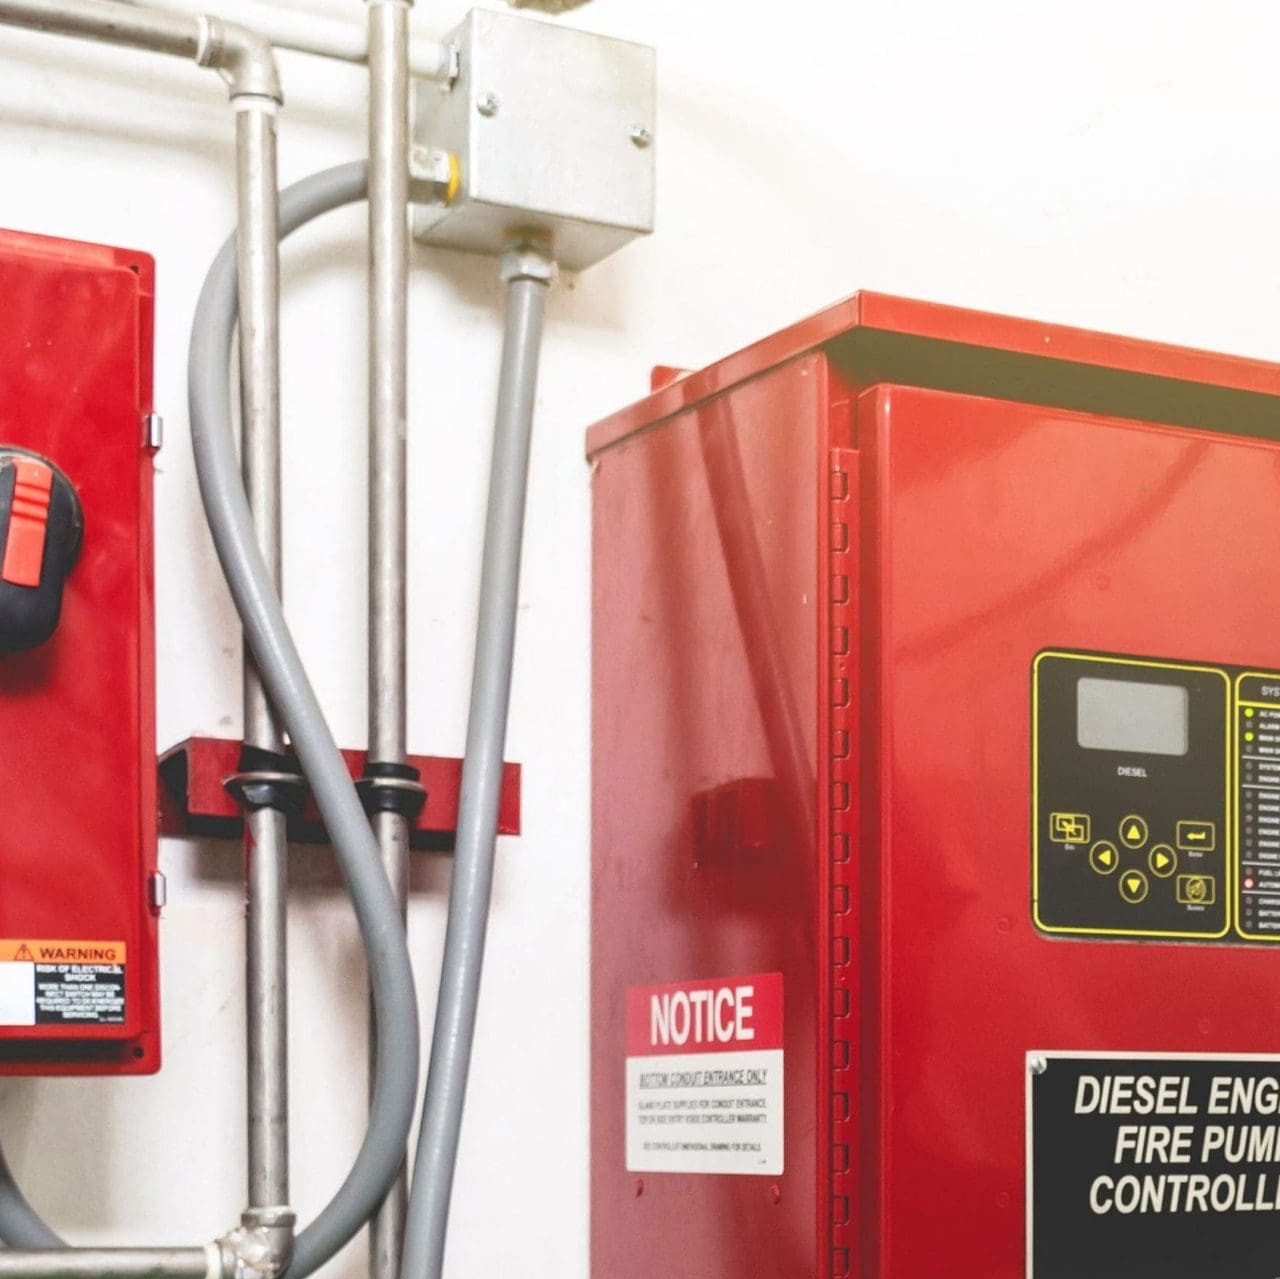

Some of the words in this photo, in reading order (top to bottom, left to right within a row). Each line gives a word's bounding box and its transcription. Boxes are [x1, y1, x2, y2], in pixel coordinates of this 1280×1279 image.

[1117, 766, 1147, 778] DIESEL
[40, 948, 116, 961] WARNING
[651, 986, 755, 1046] NOTICE
[640, 1072, 668, 1087] BOTTOM
[671, 1072, 702, 1086] CONDUIT
[704, 1070, 744, 1086] ENTRANCE
[747, 1069, 768, 1084] ONLY
[1075, 1076, 1199, 1114] DIESEL
[1114, 1126, 1194, 1164] FIRE
